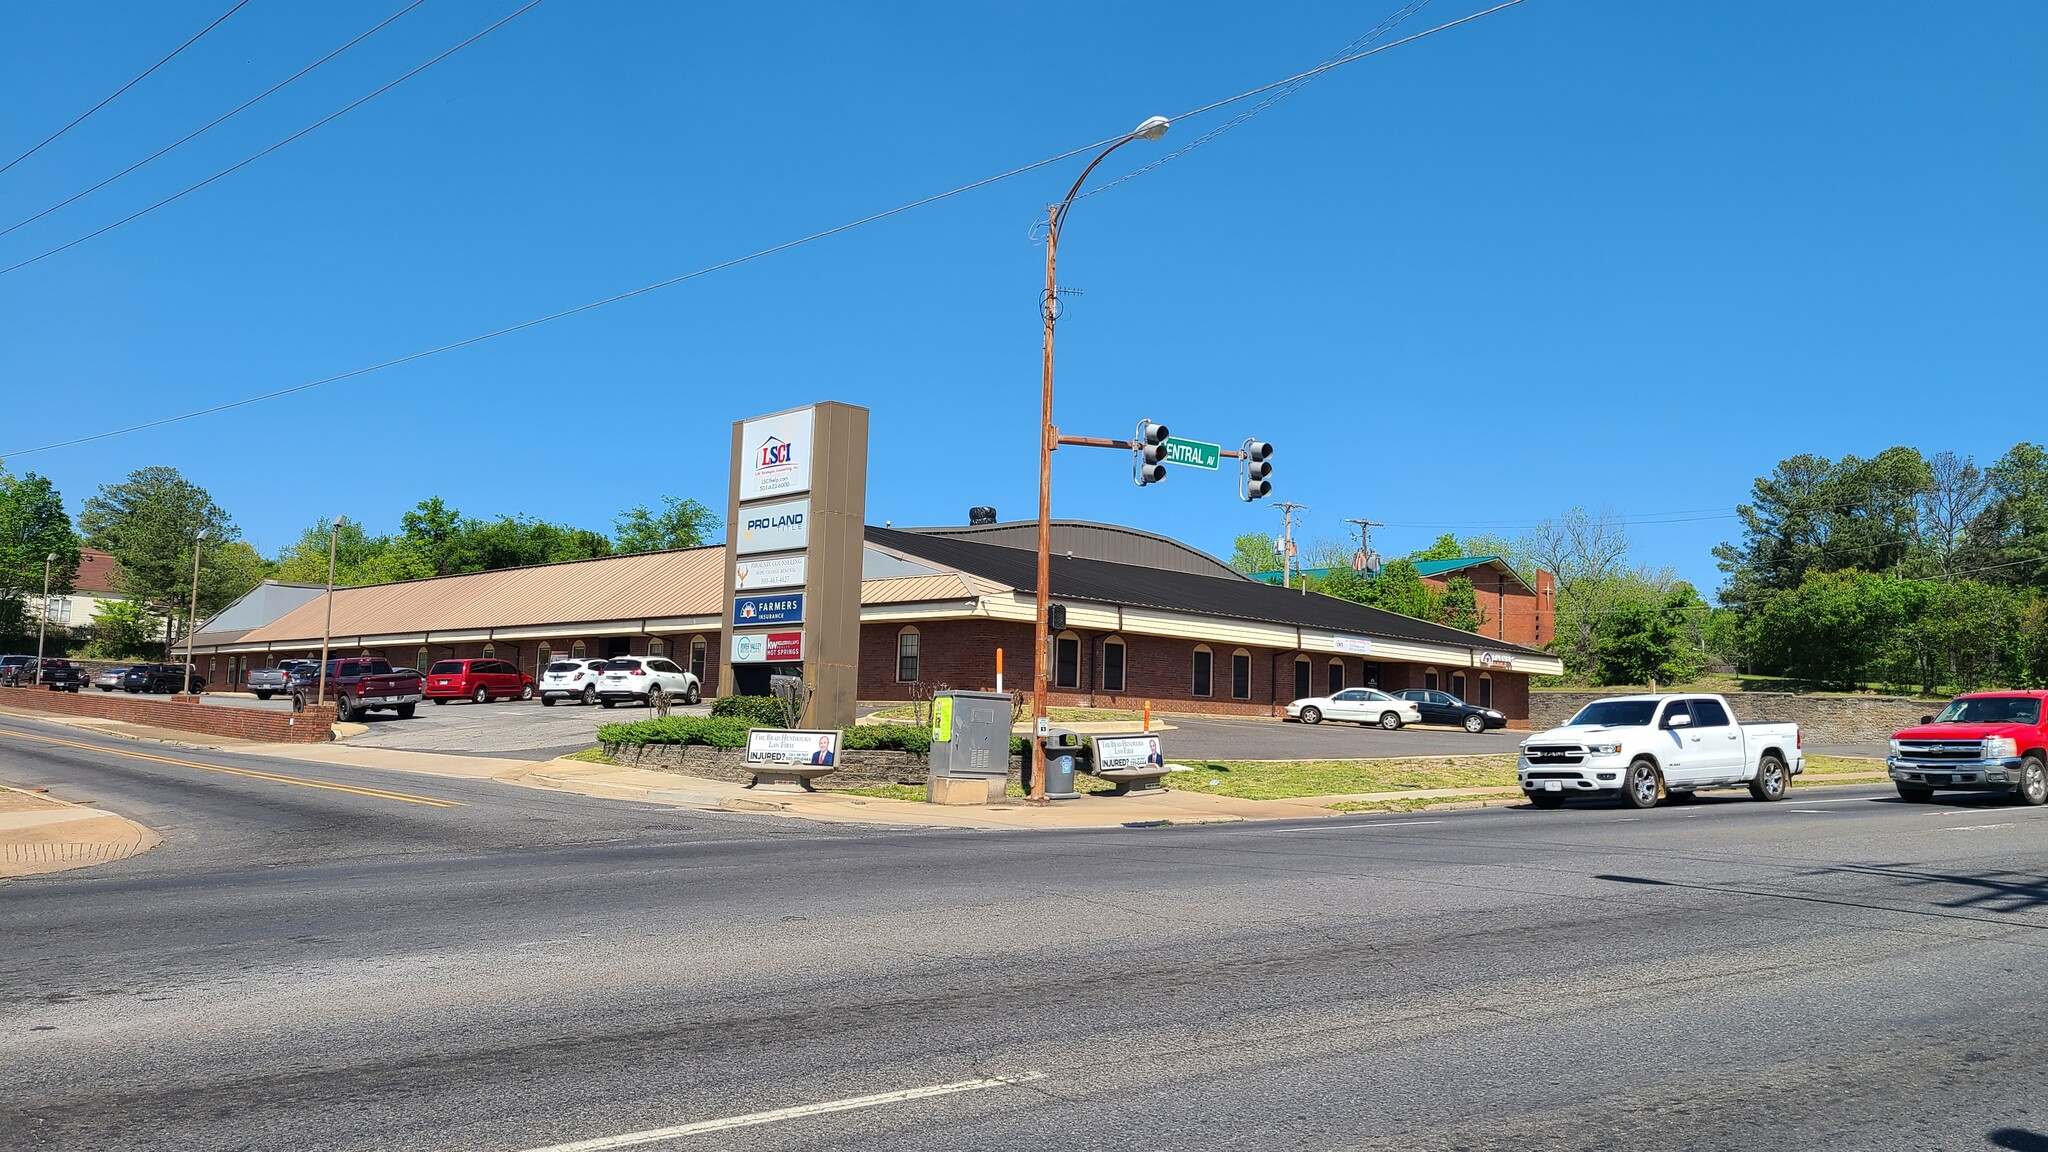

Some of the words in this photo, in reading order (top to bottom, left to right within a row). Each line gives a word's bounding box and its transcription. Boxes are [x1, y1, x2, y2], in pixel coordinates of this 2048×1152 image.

[762, 443, 791, 465] LSCI
[1163, 443, 1204, 465] ENTRAL
[1206, 456, 1215, 466] AV
[747, 517, 770, 531] PRO
[771, 513, 804, 528] LAND
[776, 524, 802, 532] TITLE
[750, 561, 772, 569] PHOENIX
[772, 558, 802, 567] COUNSELING
[758, 600, 798, 612] FARMERS
[758, 612, 785, 620] INSURANCE
[767, 638, 778, 650] kw
[777, 648, 799, 656] SPRINGS
[750, 751, 786, 761] INJURED?
[1102, 758, 1129, 767] INJURED?
